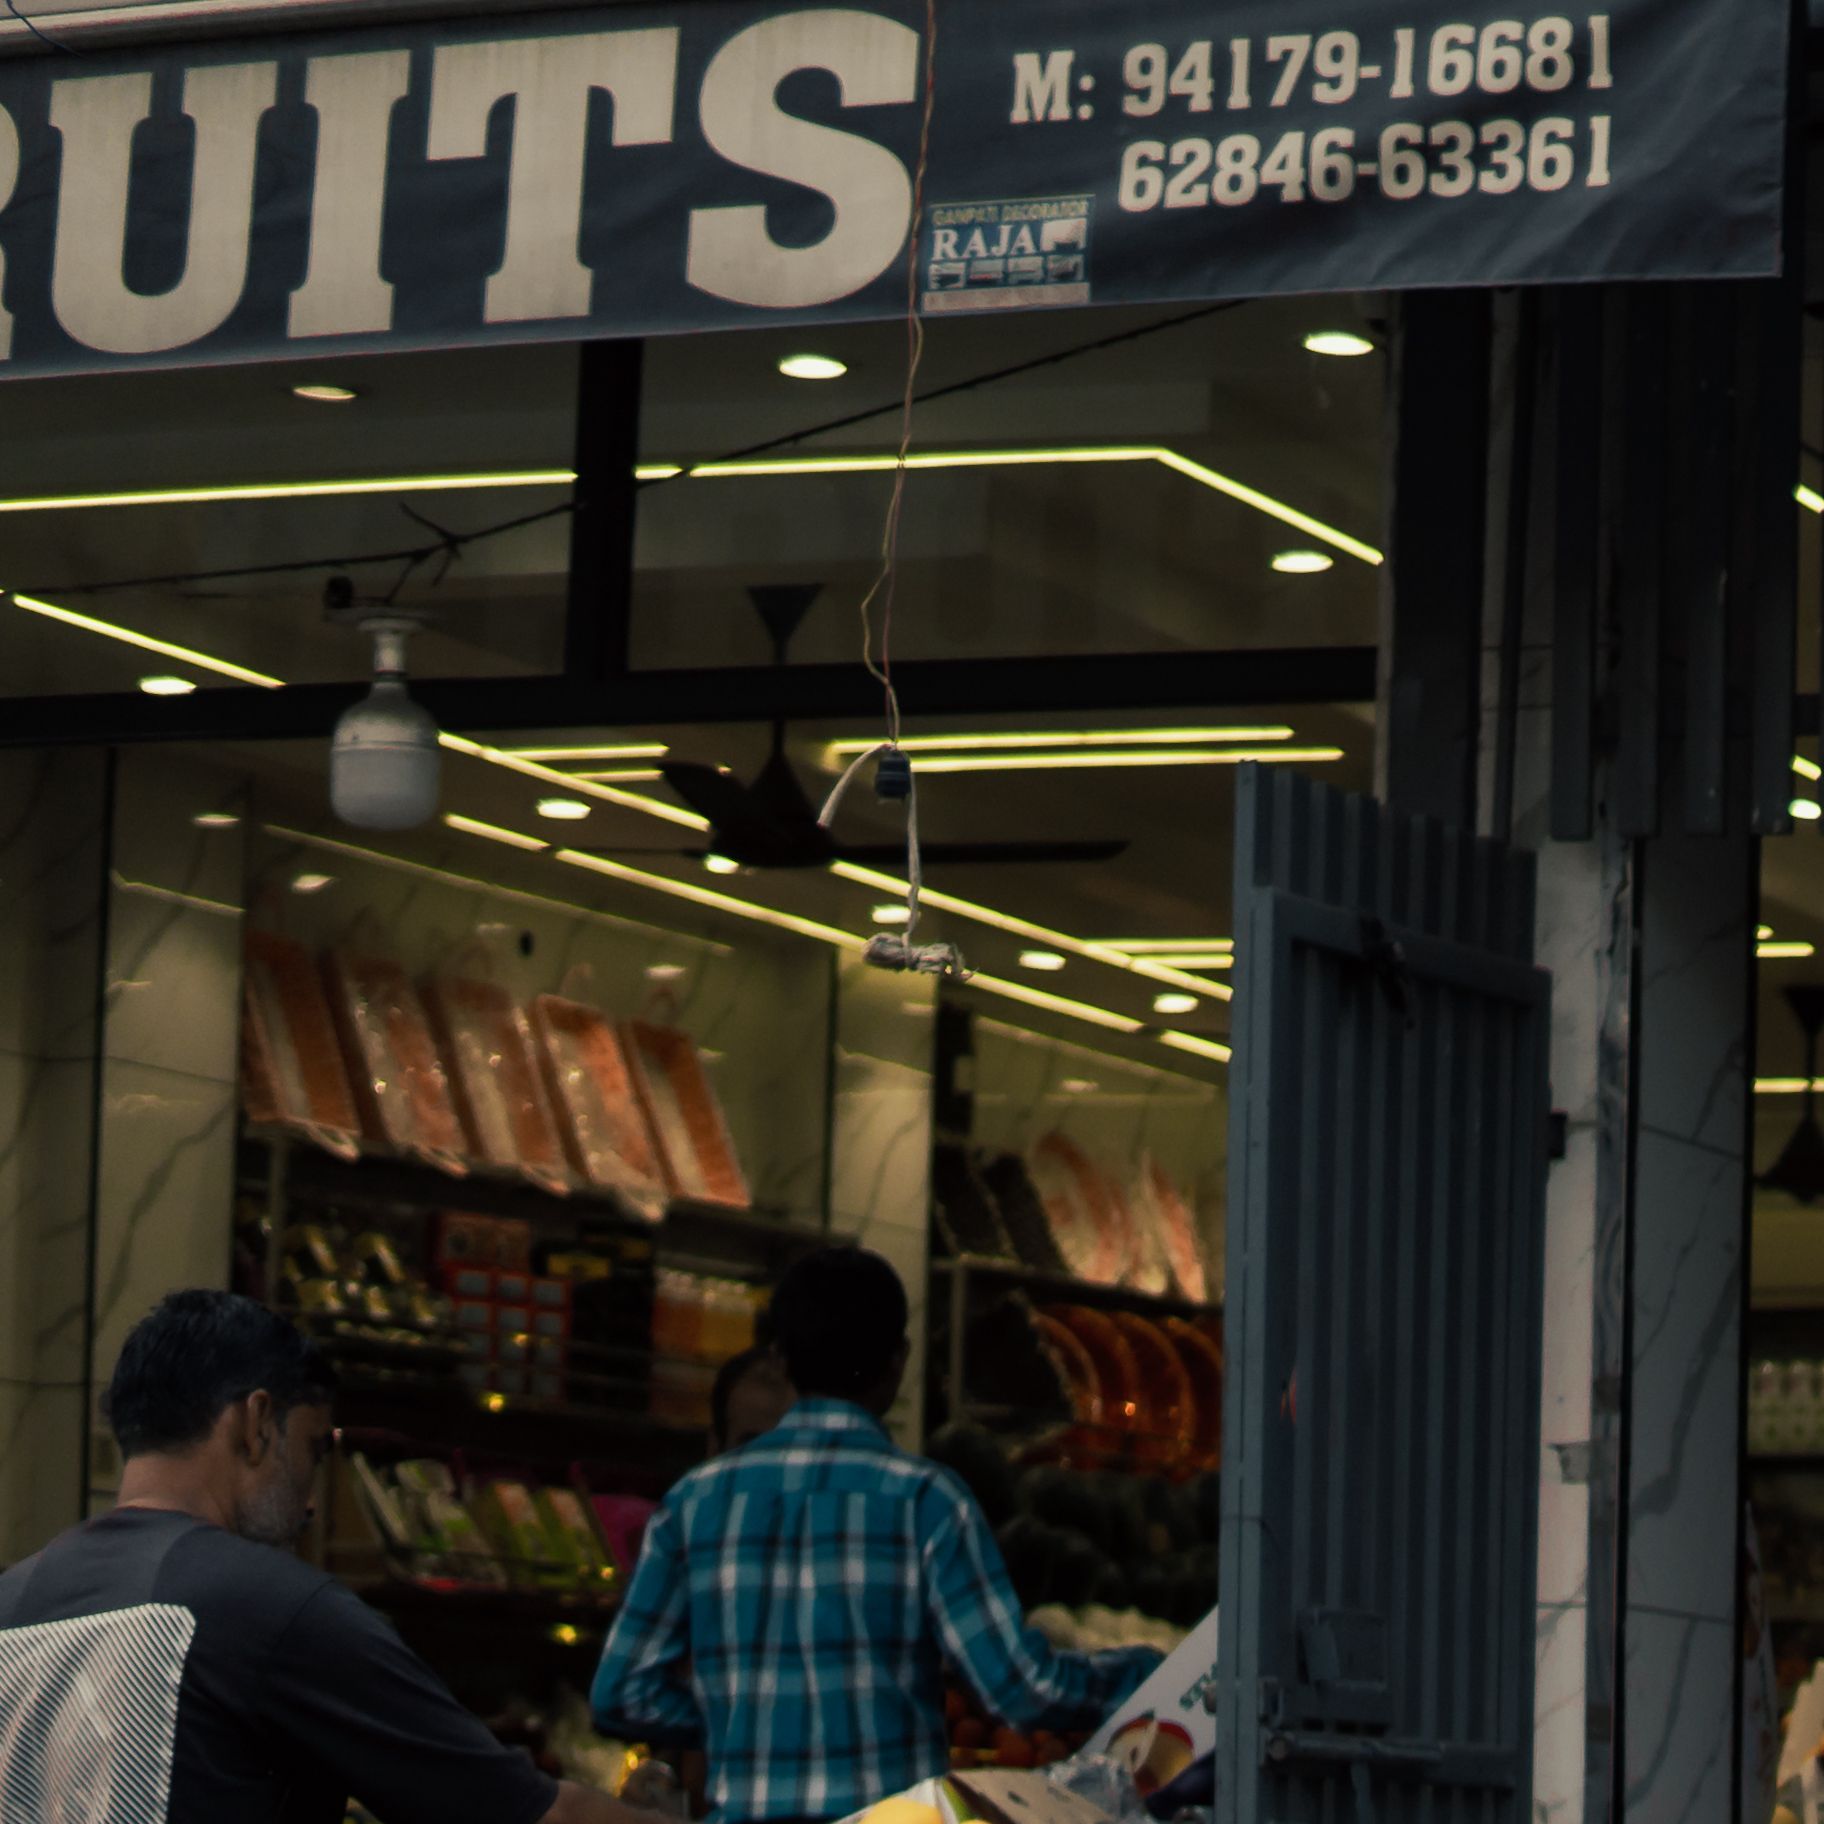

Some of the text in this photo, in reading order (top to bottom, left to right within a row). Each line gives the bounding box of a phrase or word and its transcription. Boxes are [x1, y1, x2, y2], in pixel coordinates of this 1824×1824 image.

[1009, 14, 1614, 123] M: 94179-16681
[0, 8, 920, 361] UITS
[1117, 115, 1613, 214] 62846-63361
[931, 223, 1037, 261] RAJA
